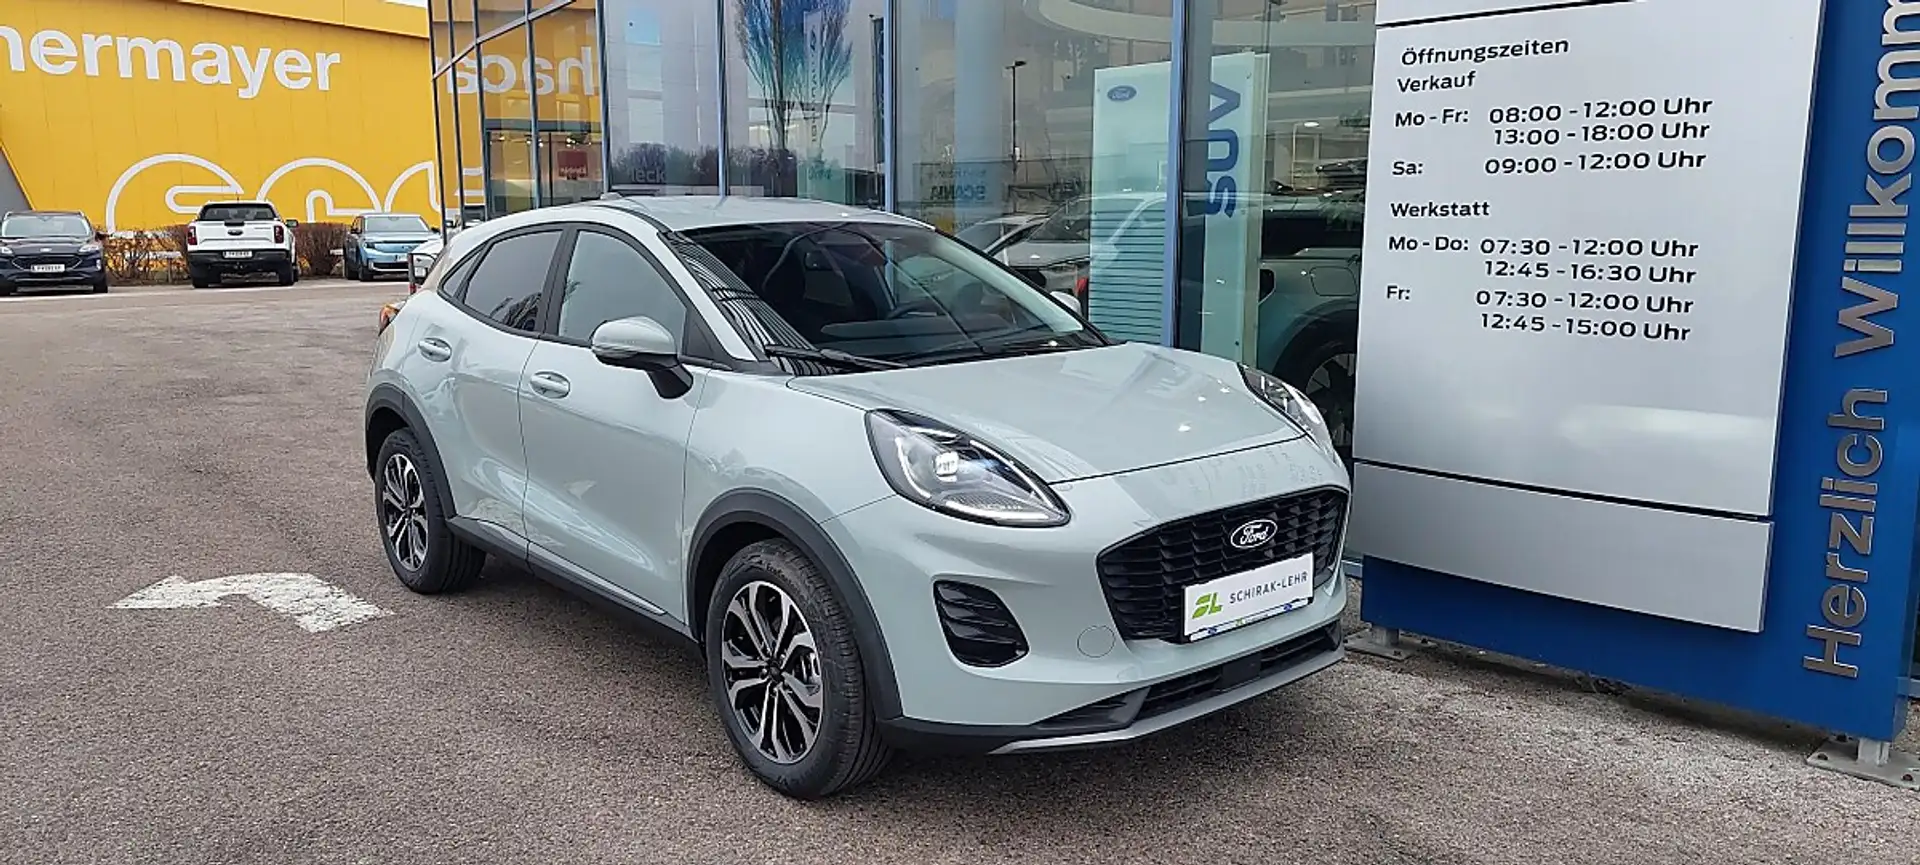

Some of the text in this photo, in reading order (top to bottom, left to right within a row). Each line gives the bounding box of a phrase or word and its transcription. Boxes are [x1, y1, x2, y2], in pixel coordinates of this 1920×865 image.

[1401, 37, 1570, 66] Öffnungszeiten
[1397, 70, 1477, 93] Verkauf
[1395, 113, 1425, 128] Mo
[1442, 108, 1469, 124] Fr:
[1489, 105, 1562, 124] 08:00
[1583, 99, 1656, 118] 12:00
[1663, 97, 1713, 115] Uhr
[1494, 129, 1560, 145] 13:00
[1581, 123, 1654, 142] 18:00
[1661, 121, 1710, 139] Uhr
[1203, 81, 1241, 218] SUV
[1392, 160, 1423, 176] Sa:
[1484, 157, 1557, 174] 09:00
[1578, 152, 1651, 171] 12:00
[1657, 150, 1707, 169] Uhr
[1390, 201, 1490, 217] Werkstatt
[1388, 236, 1418, 251] Mo
[1435, 236, 1469, 251] Do:
[1480, 238, 1551, 256] 07:30
[1572, 239, 1643, 256] 12:00
[1651, 239, 1699, 258] Uhr
[1485, 260, 1550, 278] 12:45
[1571, 263, 1641, 282] 16:30
[1648, 266, 1697, 284] Uhr
[1386, 285, 1411, 301] Fr:
[1476, 290, 1547, 309] 07:30
[1568, 292, 1640, 311] 12:00
[1646, 295, 1694, 313] Uhr
[1481, 313, 1545, 332] 12:45
[1566, 318, 1638, 338] 15:00
[1643, 322, 1691, 341] Uhr
[1240, 523, 1270, 545] Ford
[1803, 388, 1887, 678] Herzlich
[1229, 571, 1309, 604] SCHIRAK-LEHR
